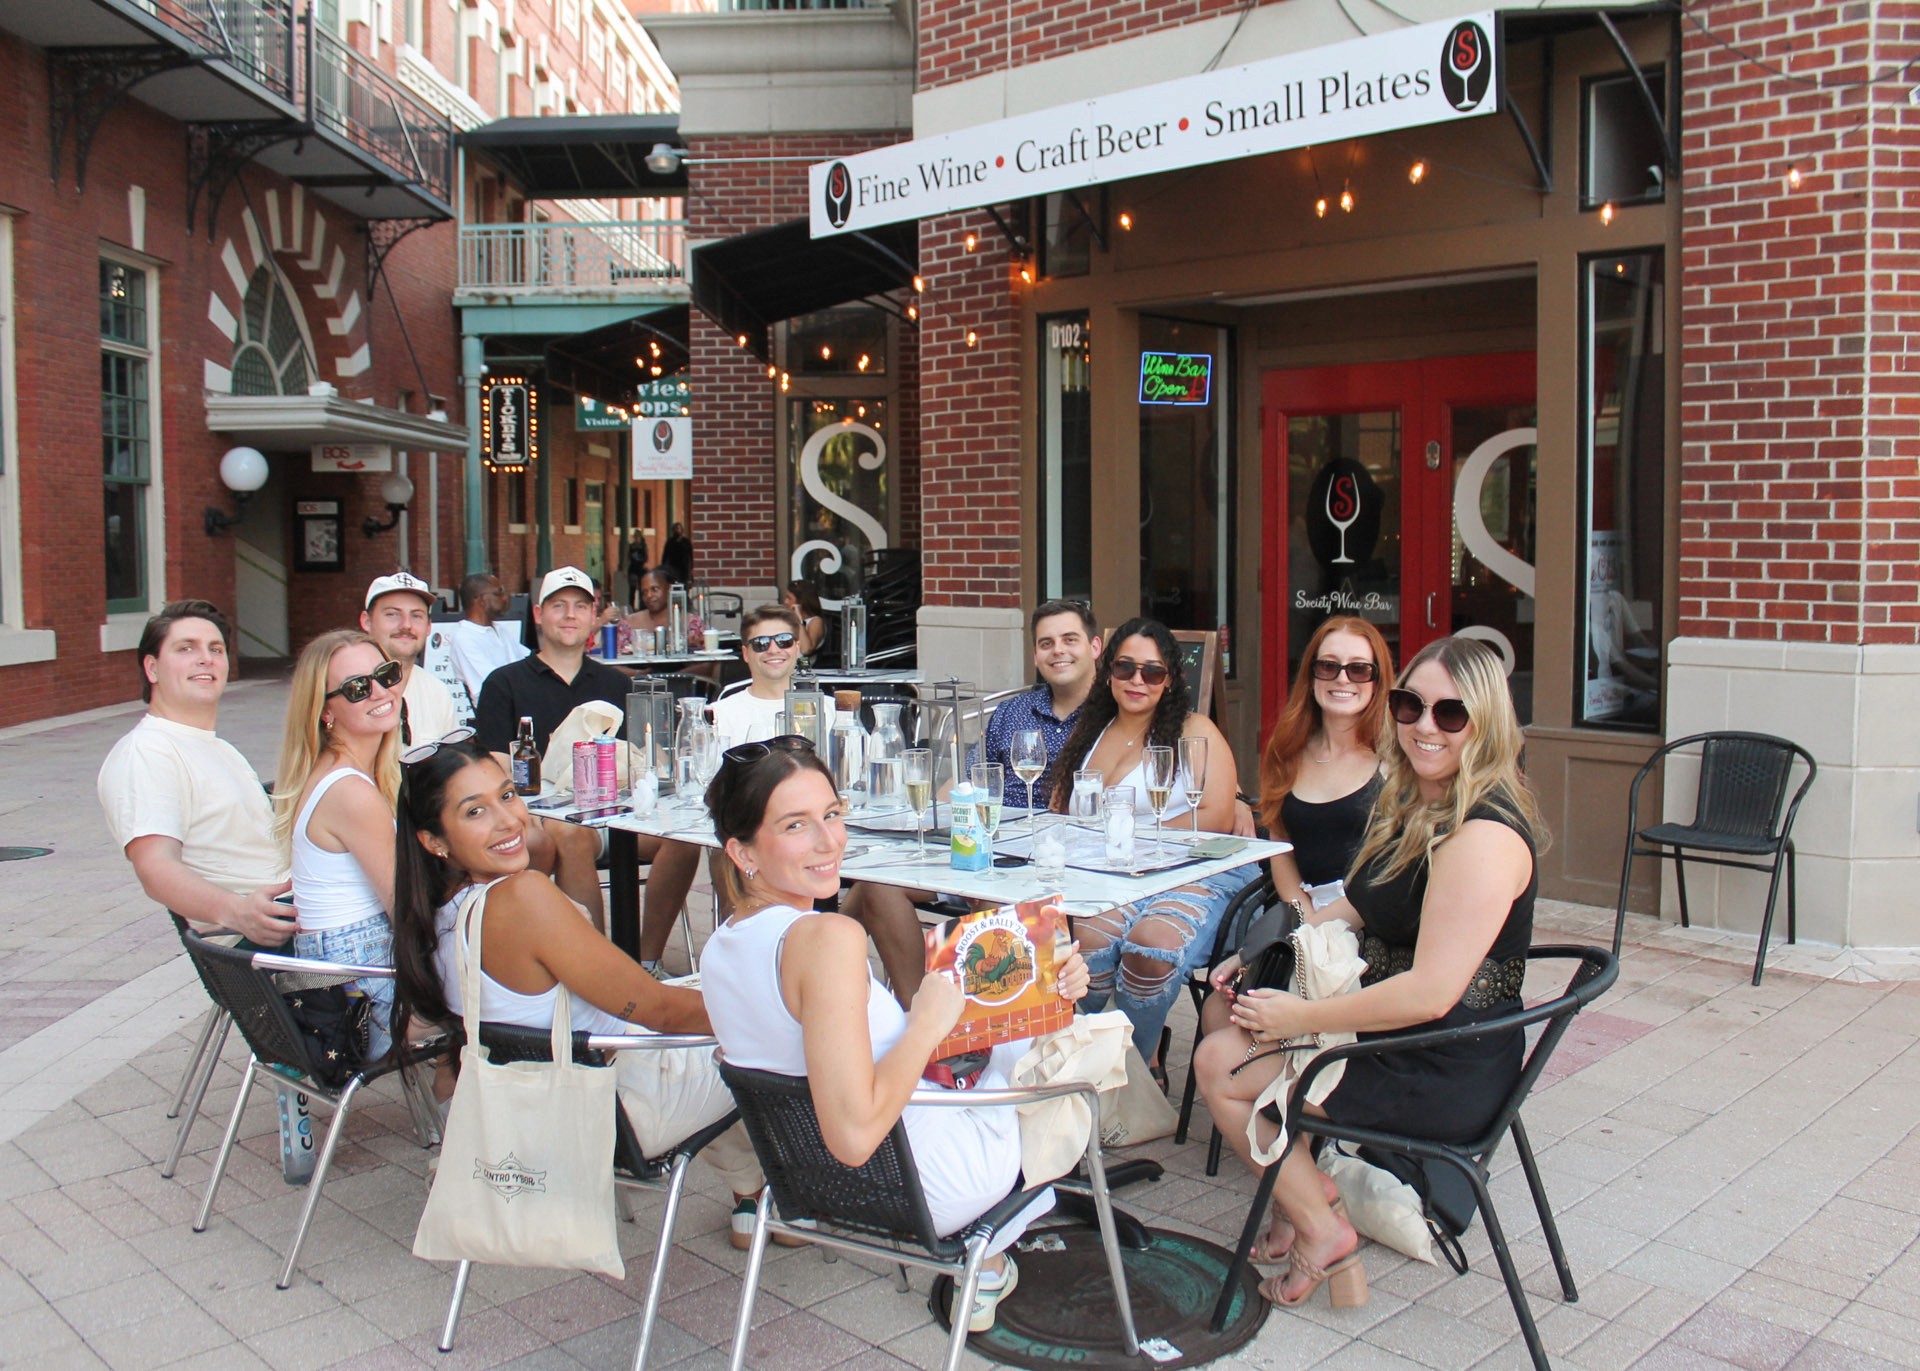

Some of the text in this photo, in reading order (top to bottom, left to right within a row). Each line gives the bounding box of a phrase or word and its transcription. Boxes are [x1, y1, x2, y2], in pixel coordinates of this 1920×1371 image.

[857, 68, 1431, 208] Fine Wine Craft Beer Small Plates
[1051, 323, 1081, 348] D102
[1143, 355, 1209, 377] Wine Bar
[1144, 375, 1188, 400] Open
[500, 388, 517, 452] TICKETS
[1295, 589, 1392, 614] Society Wine Bar
[434, 664, 449, 672] BY
[951, 807, 971, 816] COCONUT
[954, 815, 969, 824] WATER
[958, 923, 980, 952] ROOST
[979, 921, 987, 929] &
[989, 917, 1015, 929] RALLY
[512, 1173, 535, 1186] YBOR
